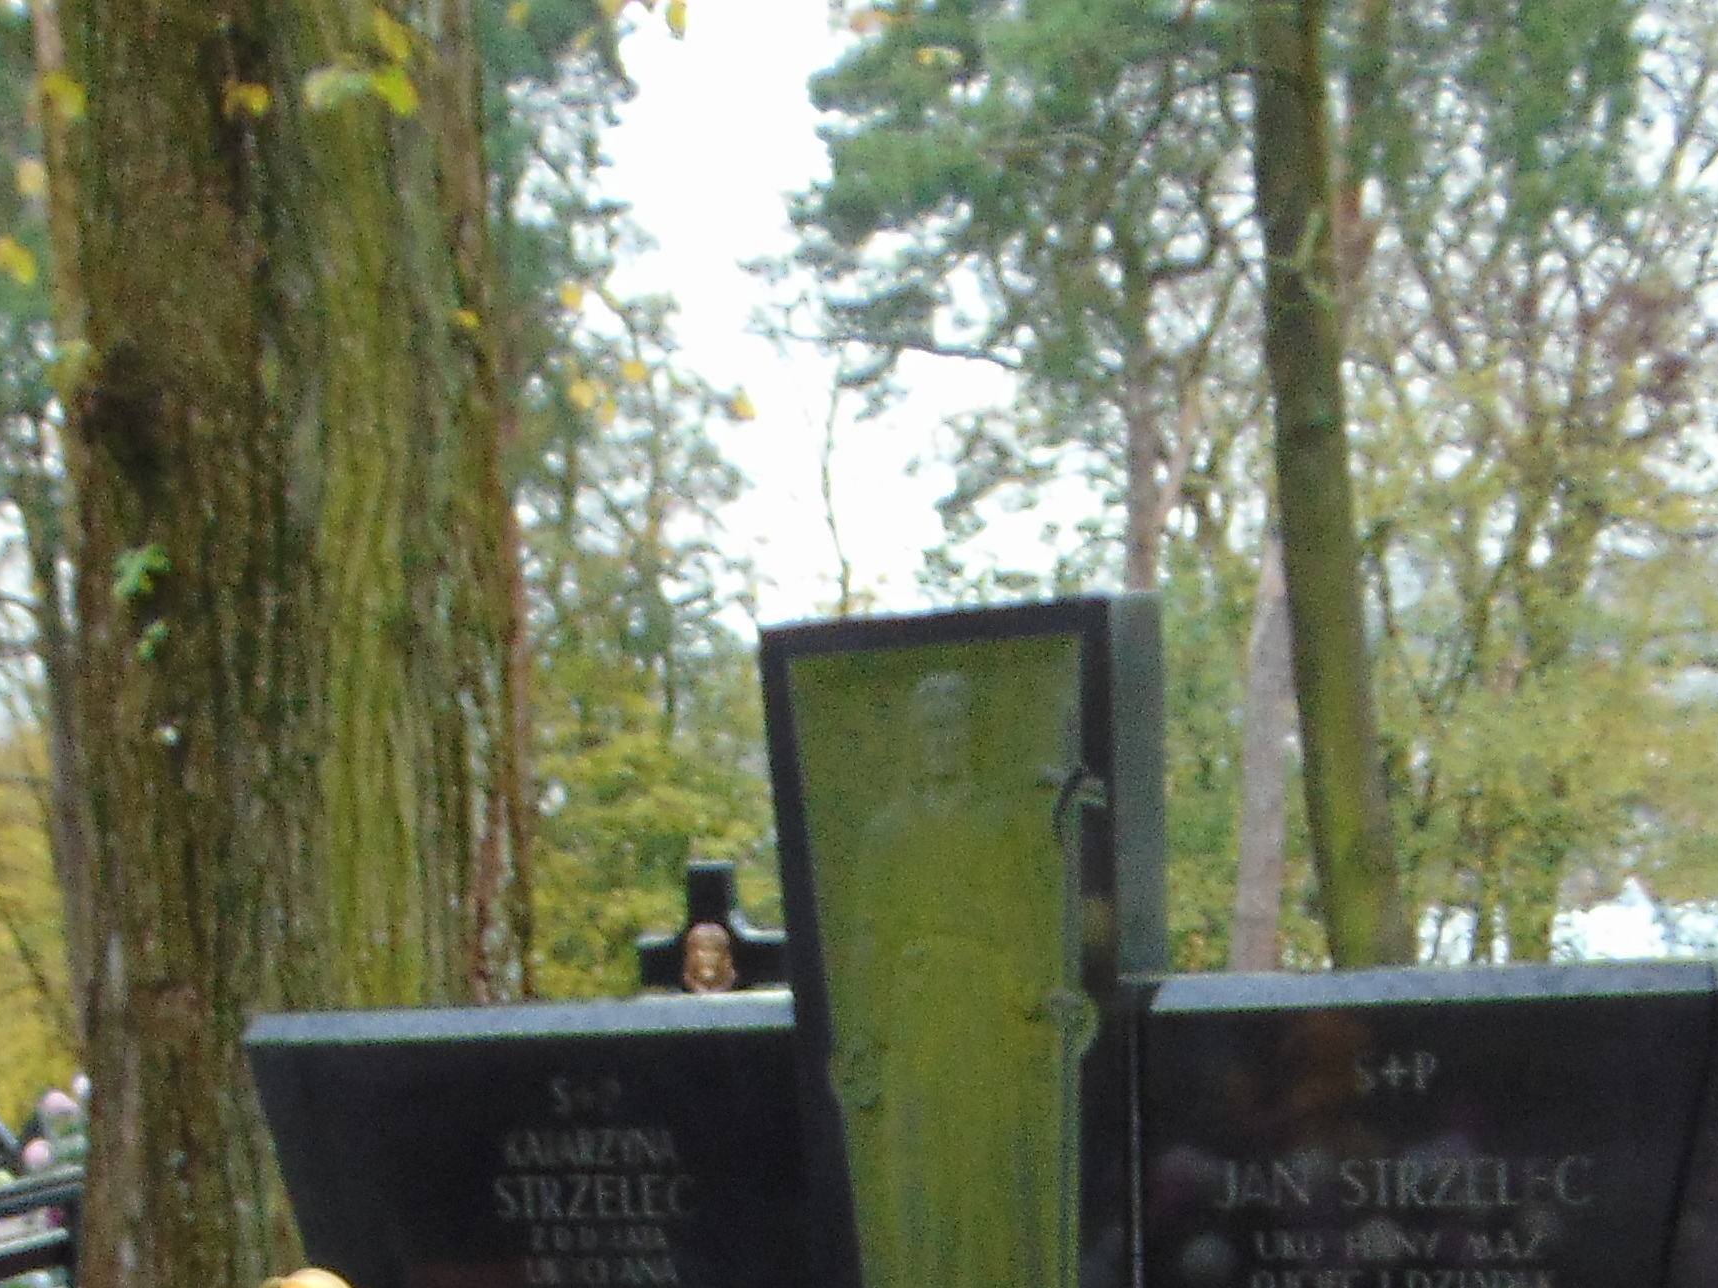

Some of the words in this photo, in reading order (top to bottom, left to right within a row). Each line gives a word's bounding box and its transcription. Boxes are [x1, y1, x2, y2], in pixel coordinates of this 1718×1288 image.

[493, 1172, 697, 1220] STRZELEC
[1213, 1159, 1312, 1210] JAN
[1338, 1154, 1593, 1208] STRZELEC
[1253, 1228, 1440, 1260] UKOHANY
